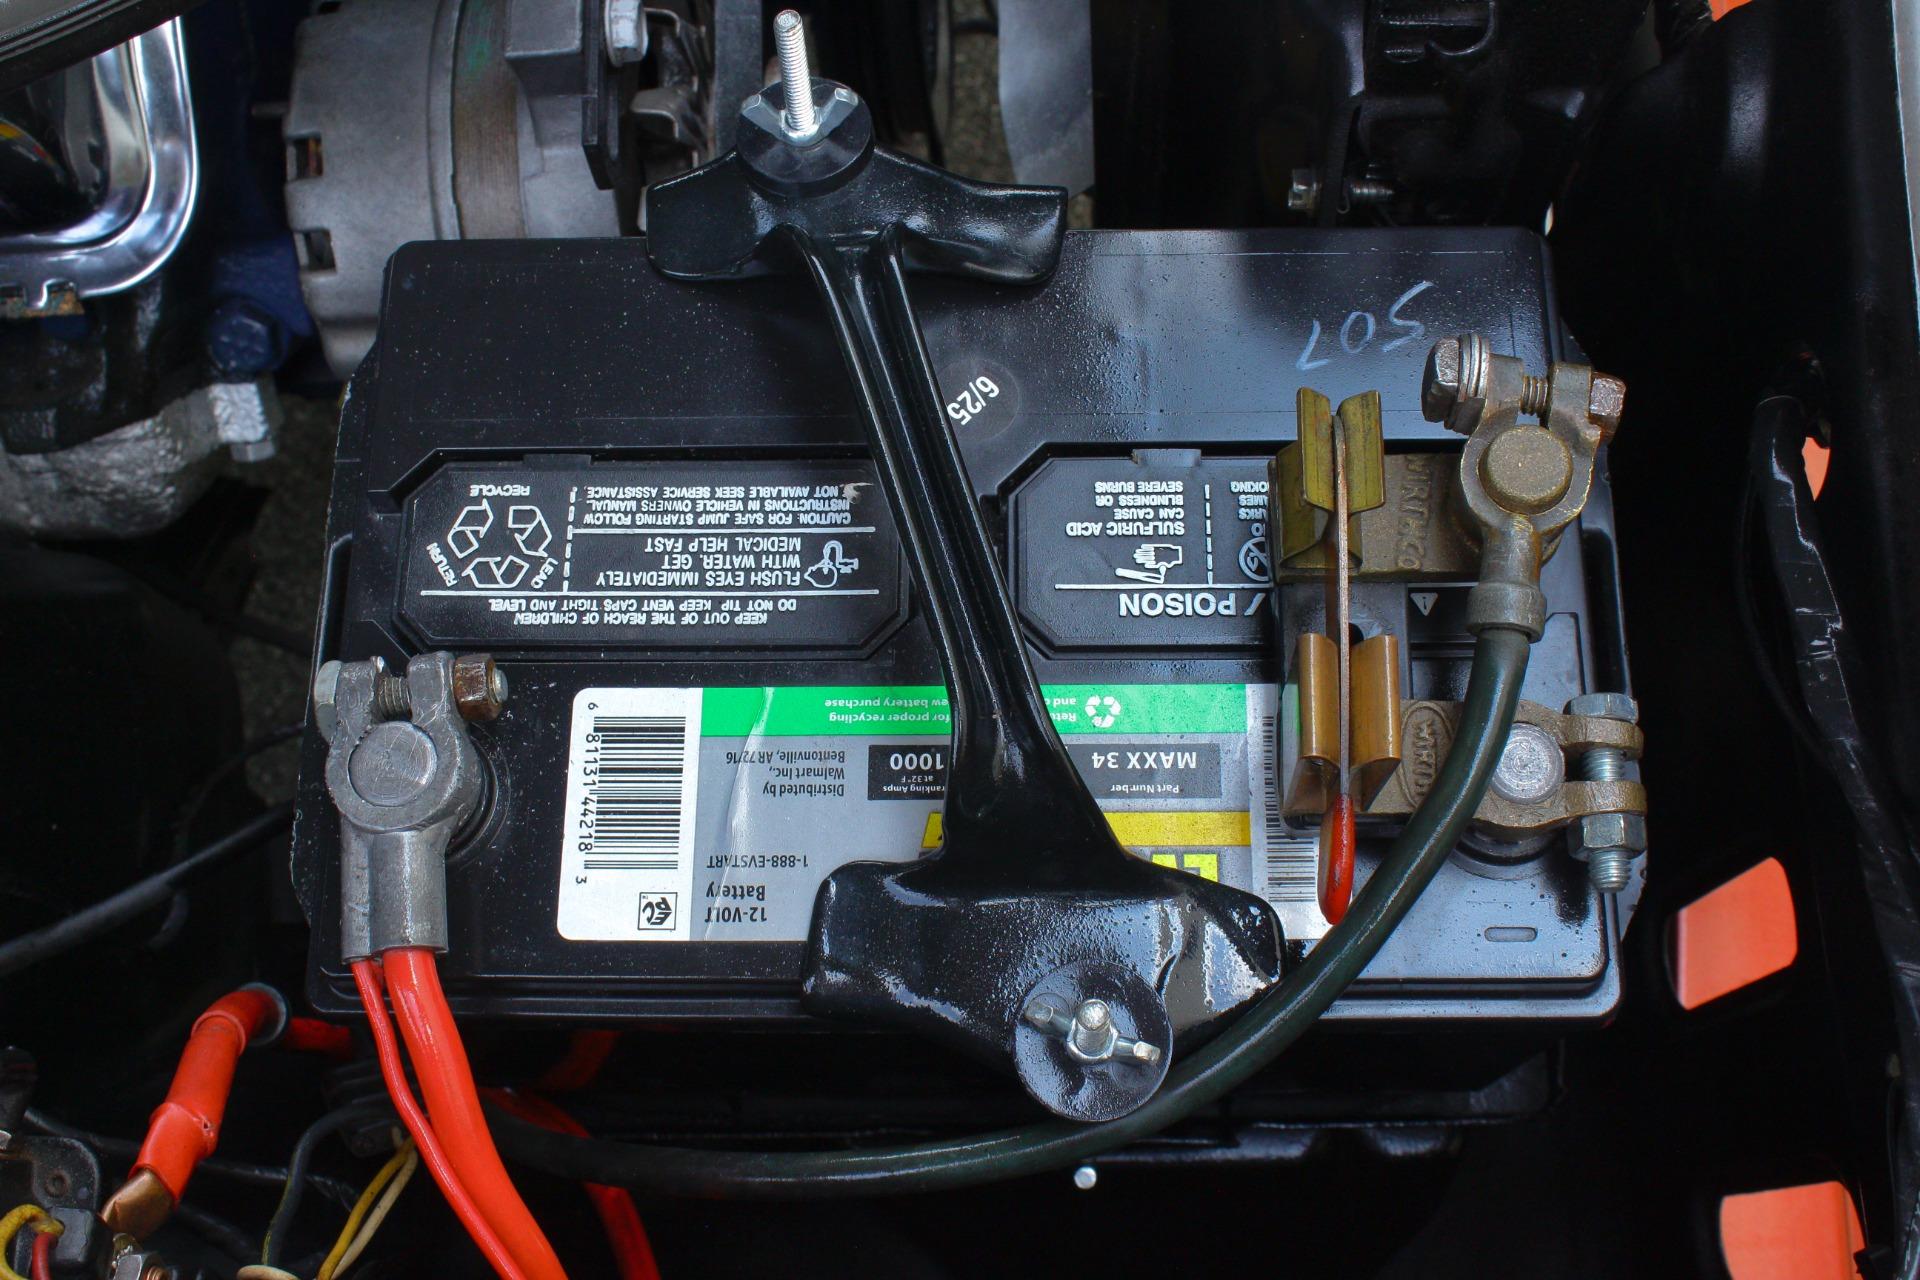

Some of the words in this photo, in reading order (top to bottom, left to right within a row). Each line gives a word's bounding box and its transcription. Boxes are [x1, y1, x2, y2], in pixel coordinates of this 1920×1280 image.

[947, 376, 1000, 426] 6/25
[469, 485, 530, 497] RECYCLE
[663, 486, 710, 498] SERVICE
[715, 486, 744, 498] SEEK
[749, 486, 809, 498] AVAILABLE
[813, 486, 839, 497] NOT
[1094, 481, 1135, 493] BURNS
[1137, 481, 1184, 493] SEVERE
[1230, 481, 1269, 492] OKING
[642, 500, 691, 511] OWNERS
[696, 500, 743, 511] VEHICLE
[748, 499, 760, 511] IN
[764, 499, 850, 511] INSTRUCTIONS
[1095, 495, 1113, 506] OR
[1119, 495, 1184, 506] BLINDNESS
[1238, 494, 1268, 506] AMES
[583, 514, 631, 525] FOLLOW
[636, 513, 694, 525] STARTING
[698, 513, 730, 525] JUMP
[735, 513, 764, 525] SAFE
[768, 512, 792, 525] FOR
[796, 512, 851, 525] CAUTION:
[1114, 508, 1154, 519] CAUSE
[1159, 508, 1184, 519] CAN
[1238, 508, 1266, 519] ARKS
[1065, 522, 1103, 536] ACID
[1106, 521, 1185, 536] SULFURIC
[645, 537, 682, 552] FAST
[688, 537, 728, 552] HELP
[735, 537, 801, 552] MEDICAL
[426, 542, 457, 587] RETURN
[662, 554, 692, 569] GET
[699, 554, 755, 569] WATER.
[760, 554, 800, 569] WITH
[531, 557, 558, 589] LEAD
[596, 571, 699, 586] IMMEDIATELY
[705, 571, 744, 586] EYES
[750, 571, 800, 586] FLUSH
[489, 599, 526, 611] LEVEL
[532, 599, 556, 611] AND
[561, 599, 598, 611] TIGHT
[604, 599, 637, 611] CAPS
[642, 599, 674, 611] VENT
[679, 599, 711, 611] KEEP
[747, 599, 773, 611] NOT
[778, 599, 796, 611] DO
[1119, 592, 1236, 617] POISON
[514, 612, 578, 625] CHILDREN
[582, 612, 599, 624] OF
[604, 612, 646, 624] REACH
[653, 612, 676, 624] THE
[681, 612, 698, 624] OF
[703, 612, 730, 624] OUT
[734, 612, 768, 624] KEEP
[587, 702, 599, 710] 6
[825, 697, 880, 708] purchase
[883, 696, 928, 709] battery
[932, 699, 948, 707] ew
[1053, 697, 1076, 707] and
[829, 710, 884, 723] recycling
[887, 710, 929, 722] proper
[933, 713, 950, 723] for
[1050, 712, 1076, 722] Retu
[583, 733, 600, 787] 81131
[757, 751, 773, 764] AR
[776, 750, 845, 764] Bentonville,
[890, 753, 944, 770] 1000
[1092, 752, 1118, 769] 34
[1126, 751, 1197, 769] MAXX
[768, 765, 793, 780] Inc.,
[796, 767, 845, 780] Walmart
[924, 775, 933, 783] at
[763, 781, 776, 796] by
[779, 783, 844, 797] Distributed
[883, 784, 908, 793] Amps
[910, 783, 945, 794] ranking
[1110, 784, 1155, 793] Number
[1157, 784, 1179, 793] Part
[578, 796, 595, 852] 44218
[706, 854, 809, 869] 1-888-EVSTART
[576, 876, 587, 885] 3
[704, 906, 768, 923] 12-VOLT
